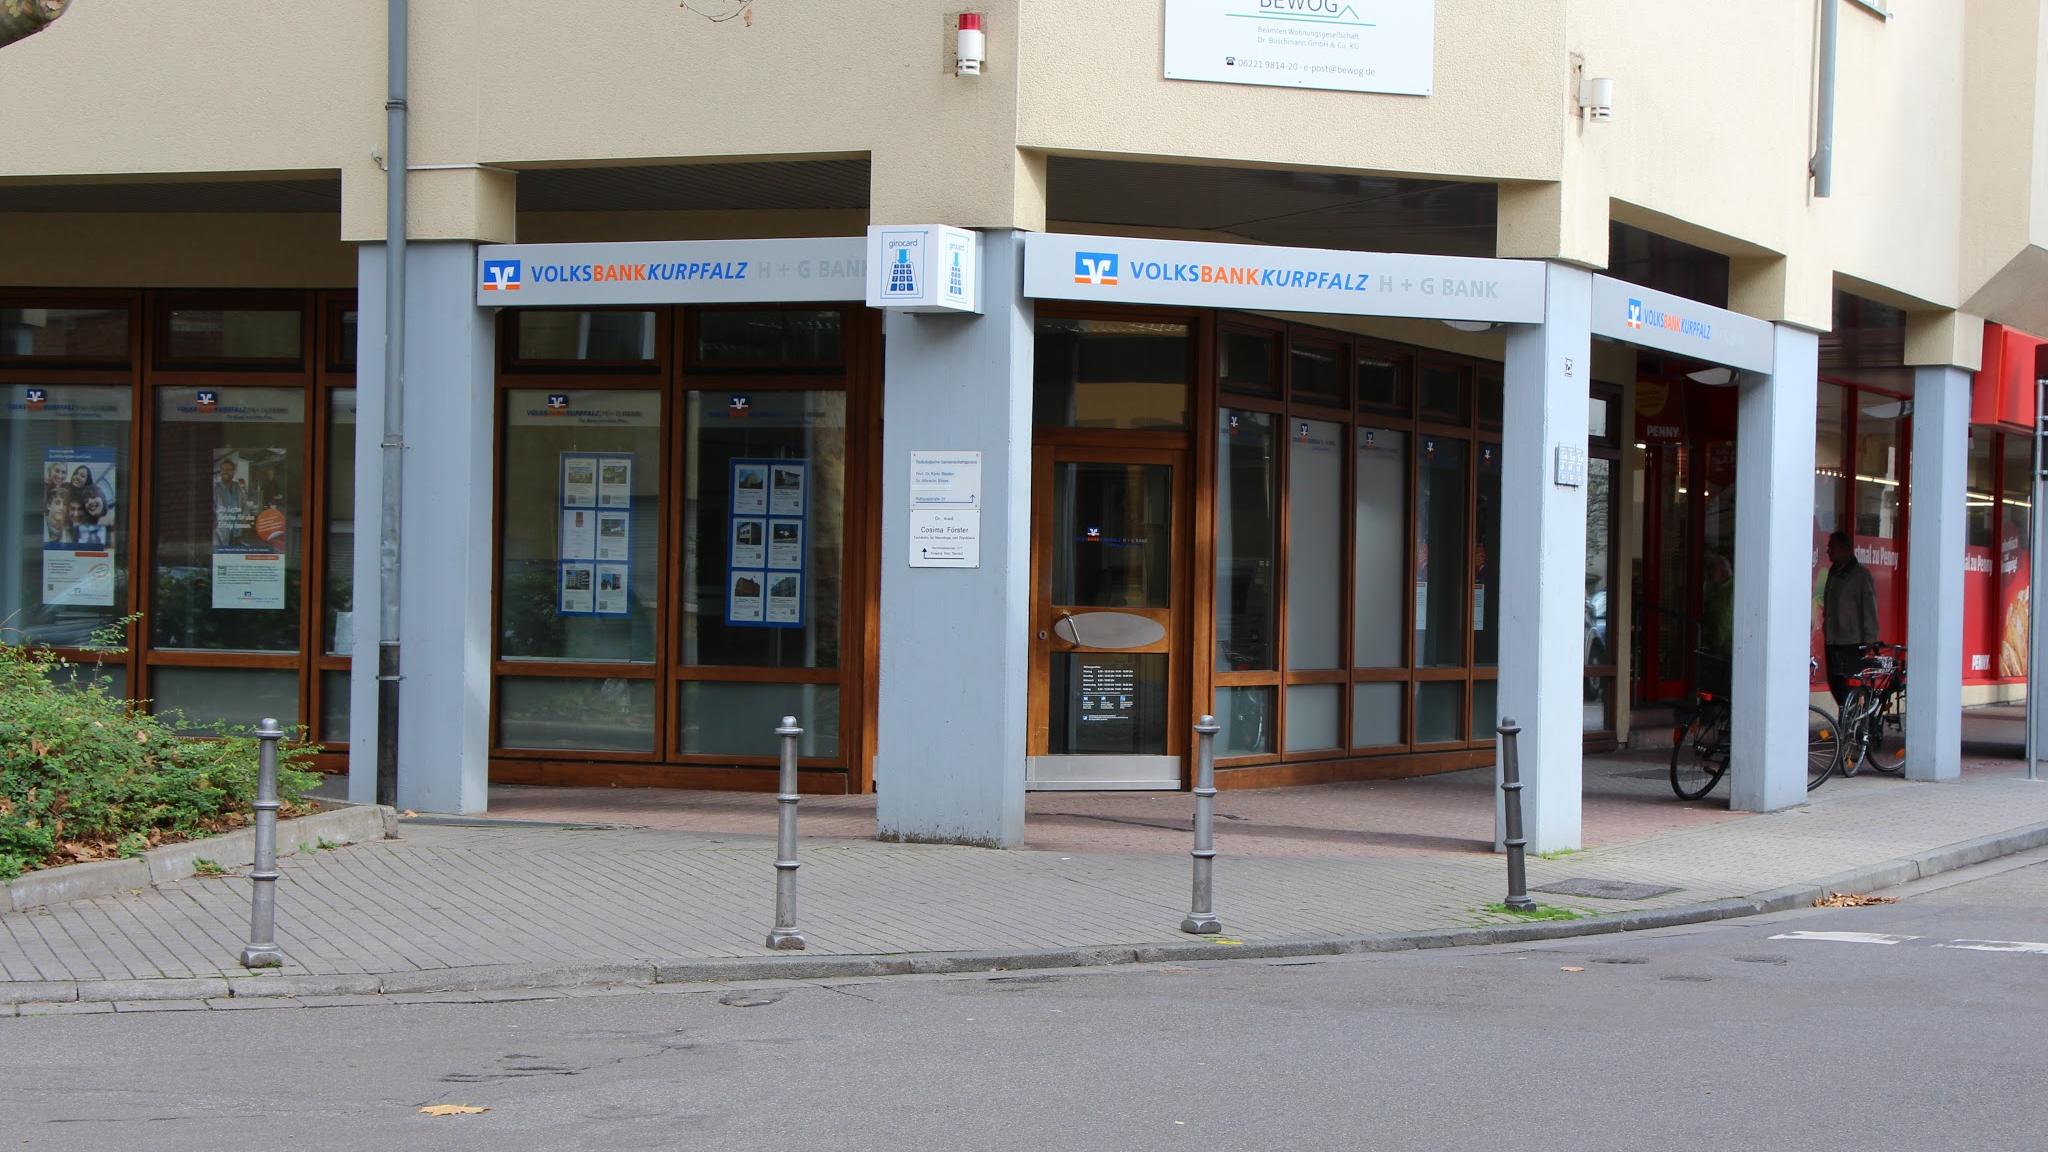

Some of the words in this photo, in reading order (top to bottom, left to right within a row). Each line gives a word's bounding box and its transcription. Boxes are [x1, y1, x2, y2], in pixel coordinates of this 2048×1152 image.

[1258, 26, 1287, 35] Beamten
[1288, 28, 1360, 40] Wohnungsgesellschaft
[1268, 37, 1308, 46] Buschmann
[1308, 40, 1329, 48] GmbH
[1238, 59, 1263, 68] 06221
[1265, 61, 1298, 71] 9814-20
[1303, 64, 1376, 77] e-post@bewog.de
[889, 239, 918, 249] girocard
[531, 261, 748, 284] VOLKSBANKKURPFALZ
[758, 261, 770, 279] H
[776, 264, 790, 275] +
[798, 260, 811, 278] G
[1130, 261, 1369, 292] VOLKSBANKKURPFALZ
[1379, 275, 1393, 293] H
[1401, 279, 1414, 292] +
[1420, 277, 1434, 296] G
[1442, 277, 1500, 299] BANK
[1644, 308, 1712, 340] VOLKSBANKKURPFALZ
[1855, 544, 1872, 564] stmal
[1872, 549, 1880, 565] zu
[1880, 546, 1899, 570] Penny
[1971, 557, 1977, 571] zu
[1977, 554, 1993, 577] Penny
